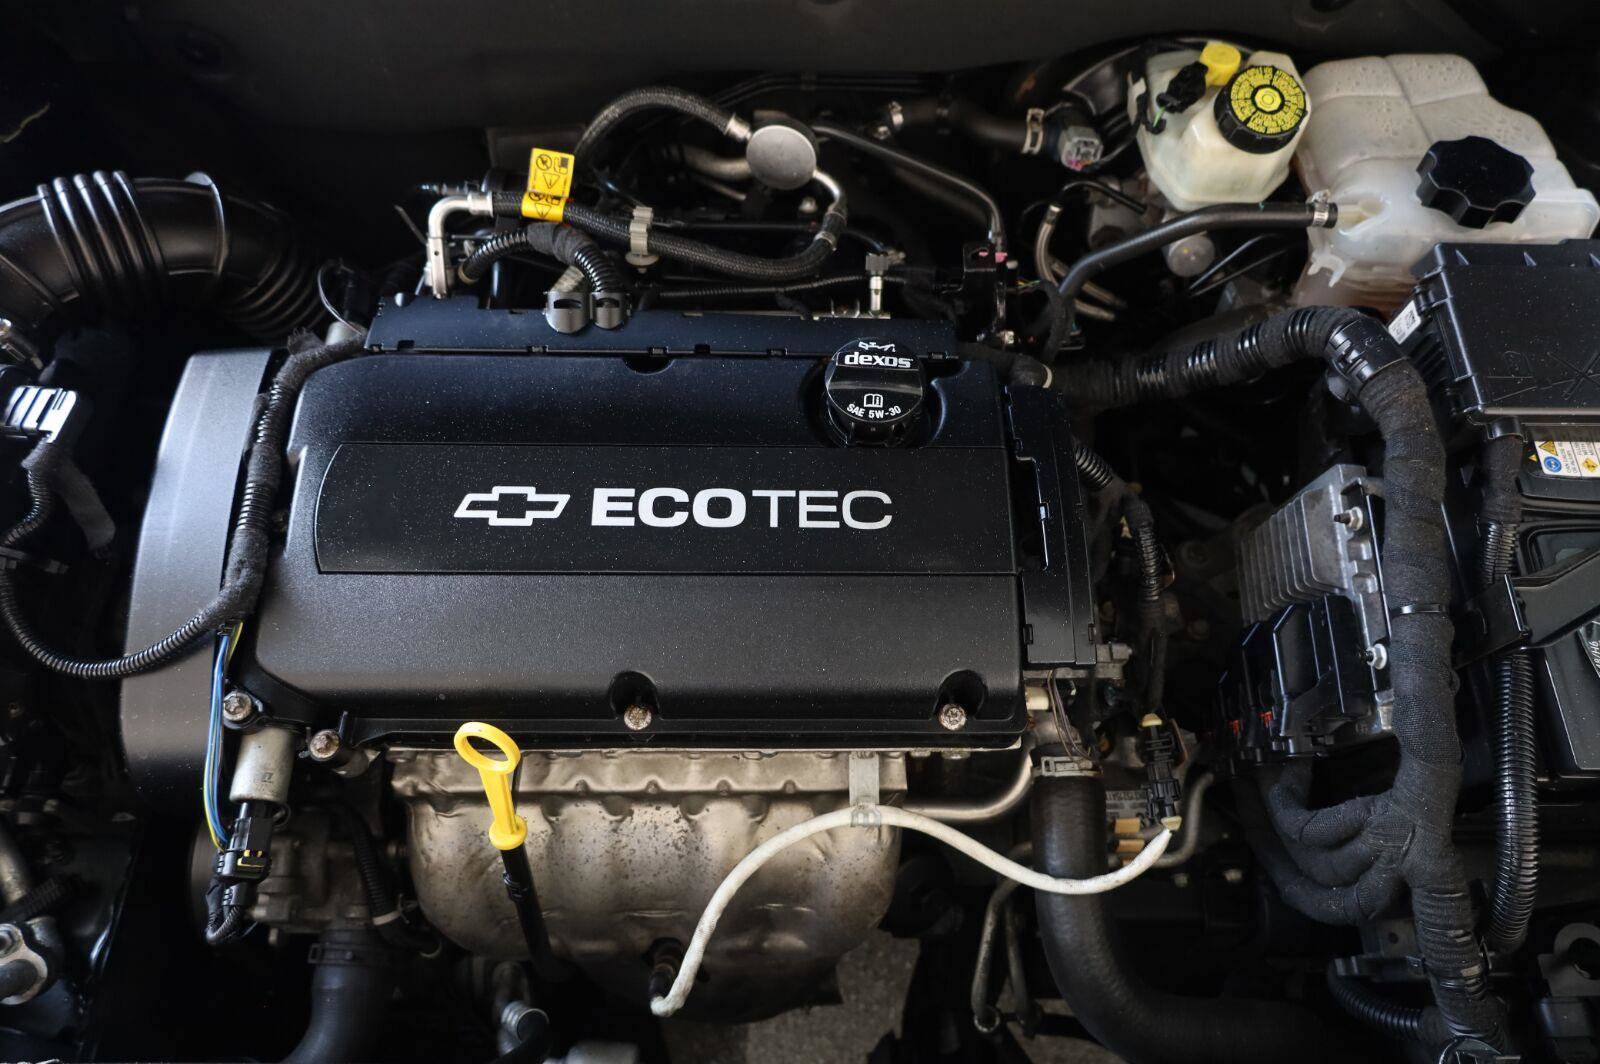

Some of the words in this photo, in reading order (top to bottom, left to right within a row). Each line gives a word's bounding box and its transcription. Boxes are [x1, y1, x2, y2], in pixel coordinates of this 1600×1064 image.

[844, 351, 911, 368] dexos
[847, 403, 866, 418] SAE
[868, 405, 901, 419] 5W-30
[590, 487, 893, 530] ECOTEC
